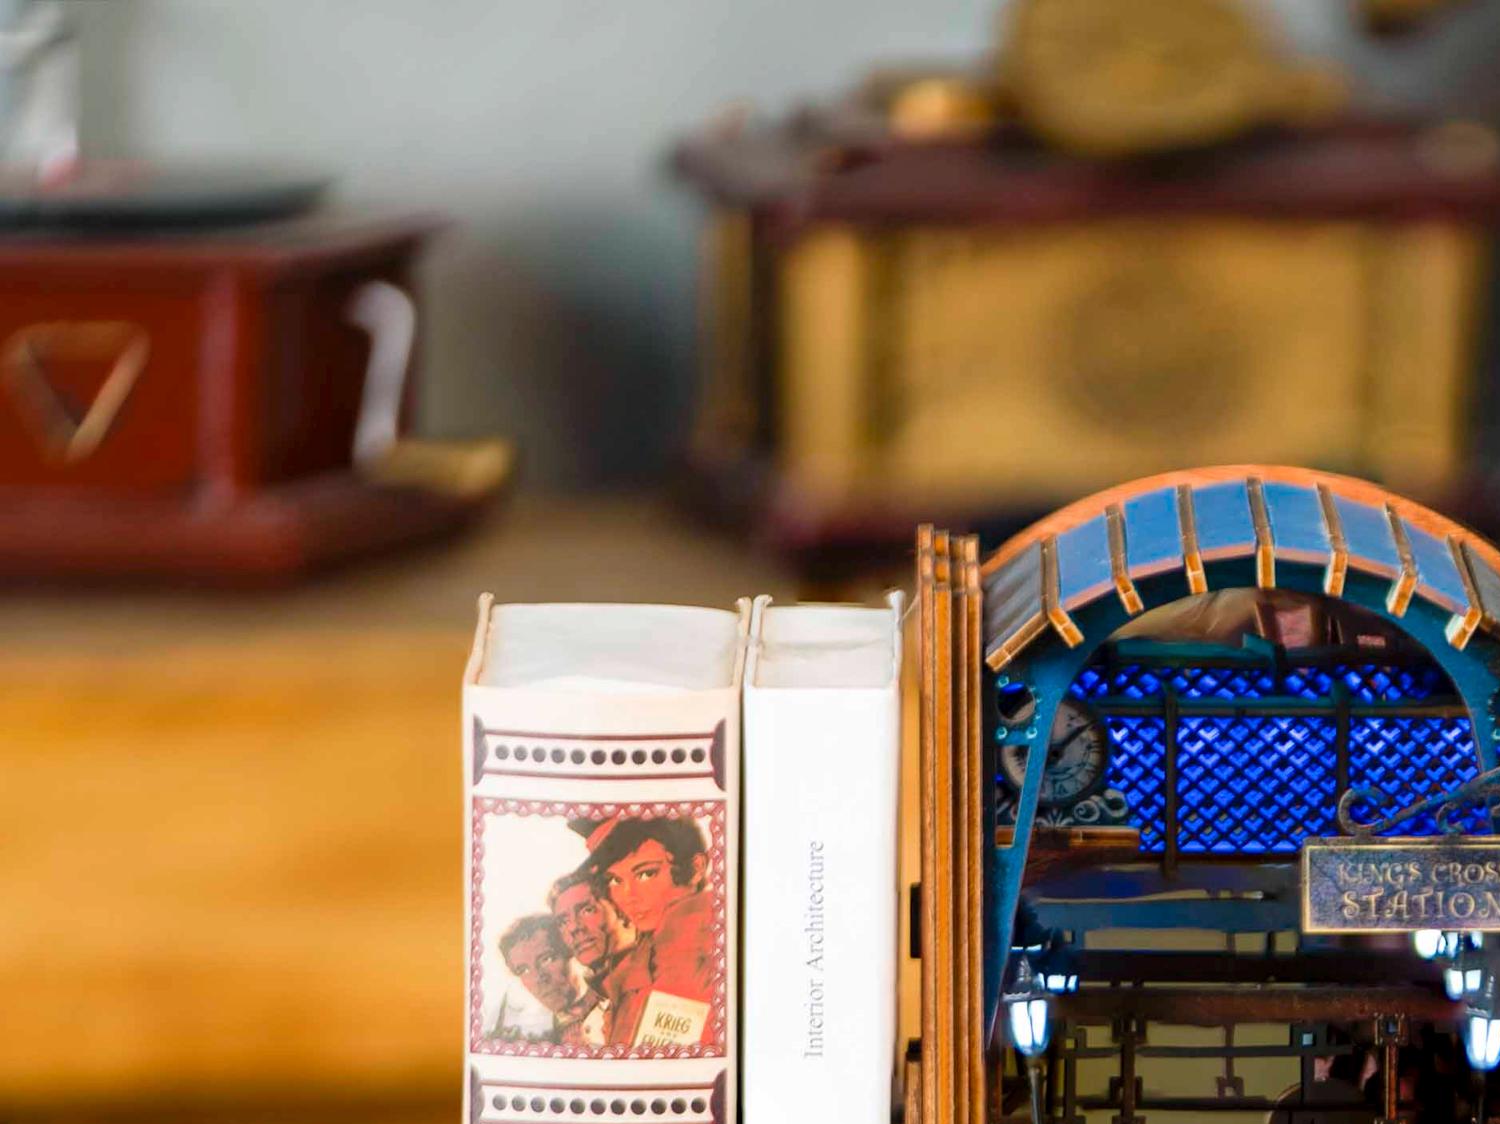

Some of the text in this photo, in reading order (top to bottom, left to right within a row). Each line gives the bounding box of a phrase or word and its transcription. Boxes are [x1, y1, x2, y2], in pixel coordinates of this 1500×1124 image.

[804, 840, 824, 1058] Interior Architecture
[654, 1010, 692, 1034] KRIEG
